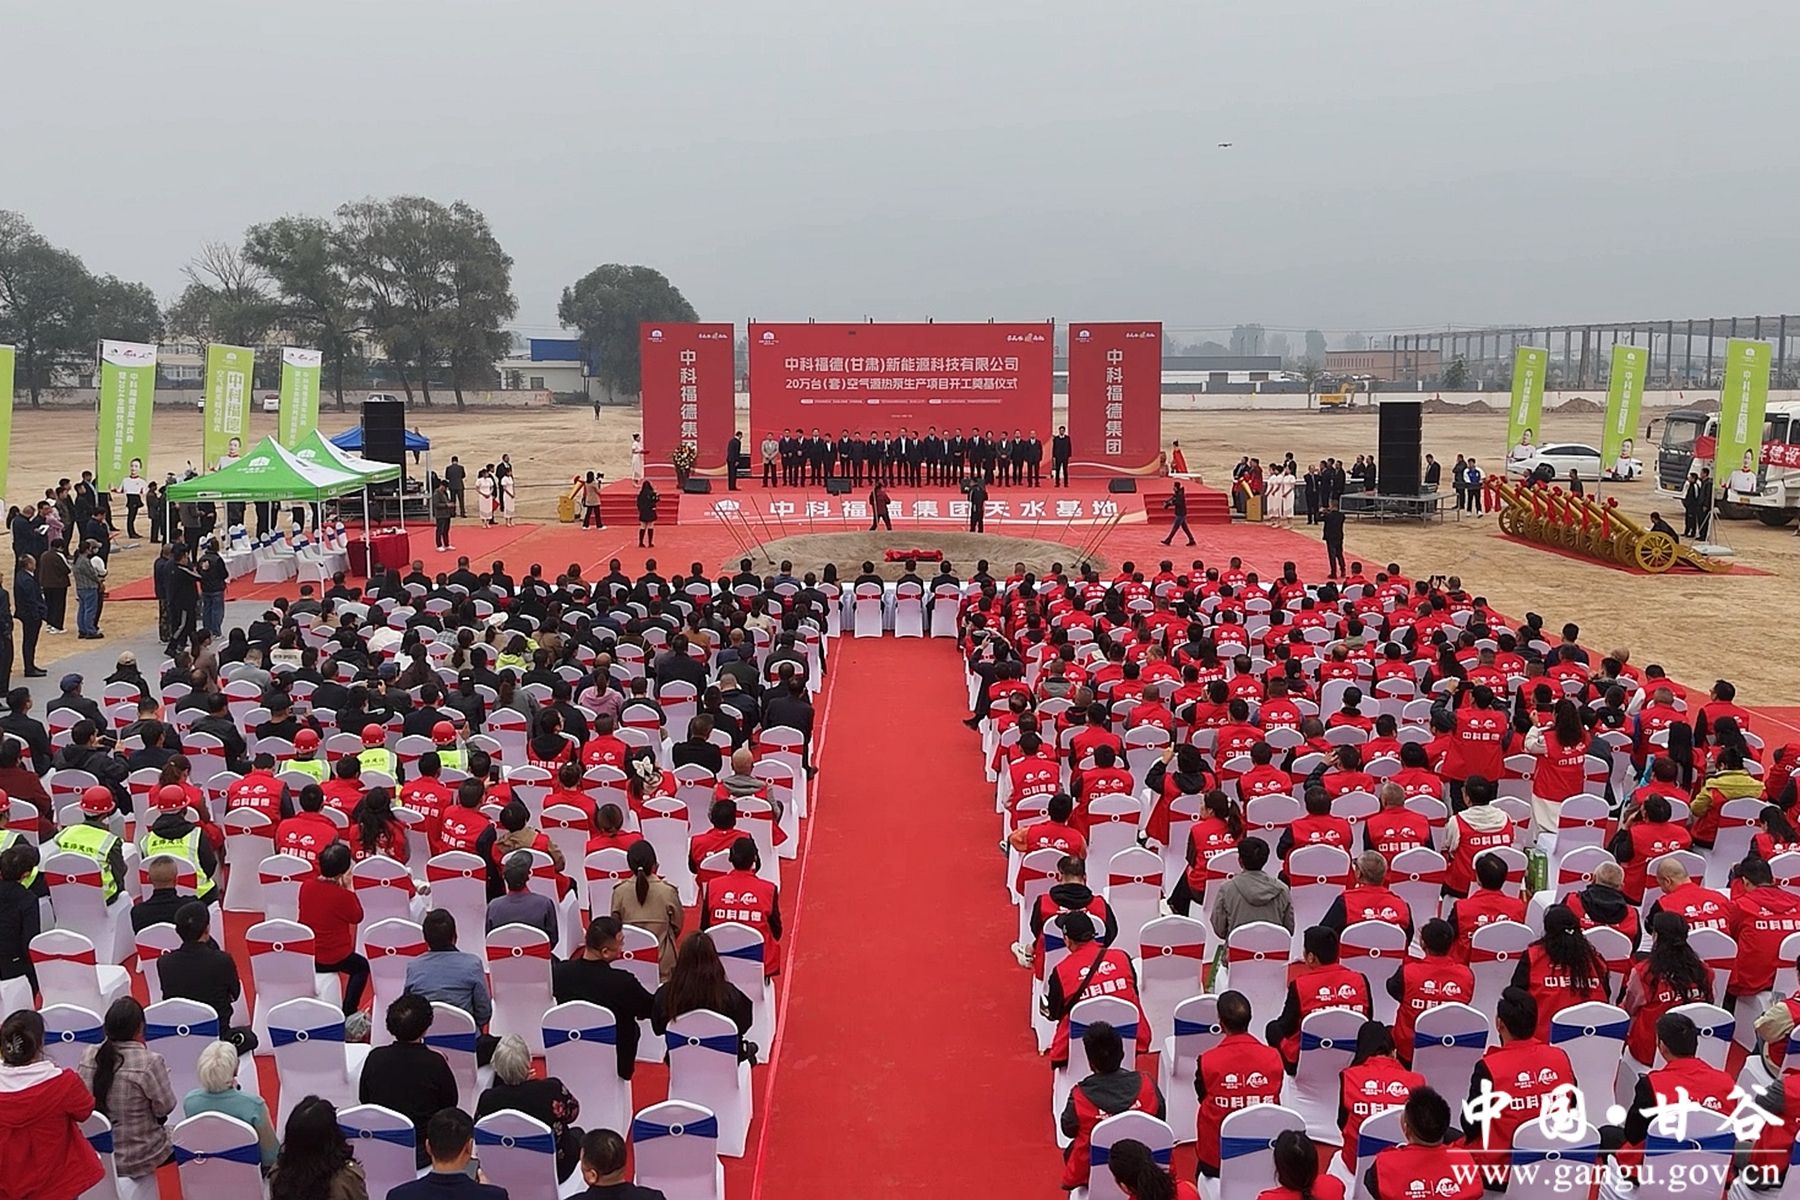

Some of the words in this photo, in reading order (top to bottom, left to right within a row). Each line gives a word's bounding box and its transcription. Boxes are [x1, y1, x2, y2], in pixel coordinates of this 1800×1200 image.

[784, 356, 1019, 373] 中科福德(甘肃)新能源科技有限公司
[1105, 349, 1123, 455] 中科福德集团
